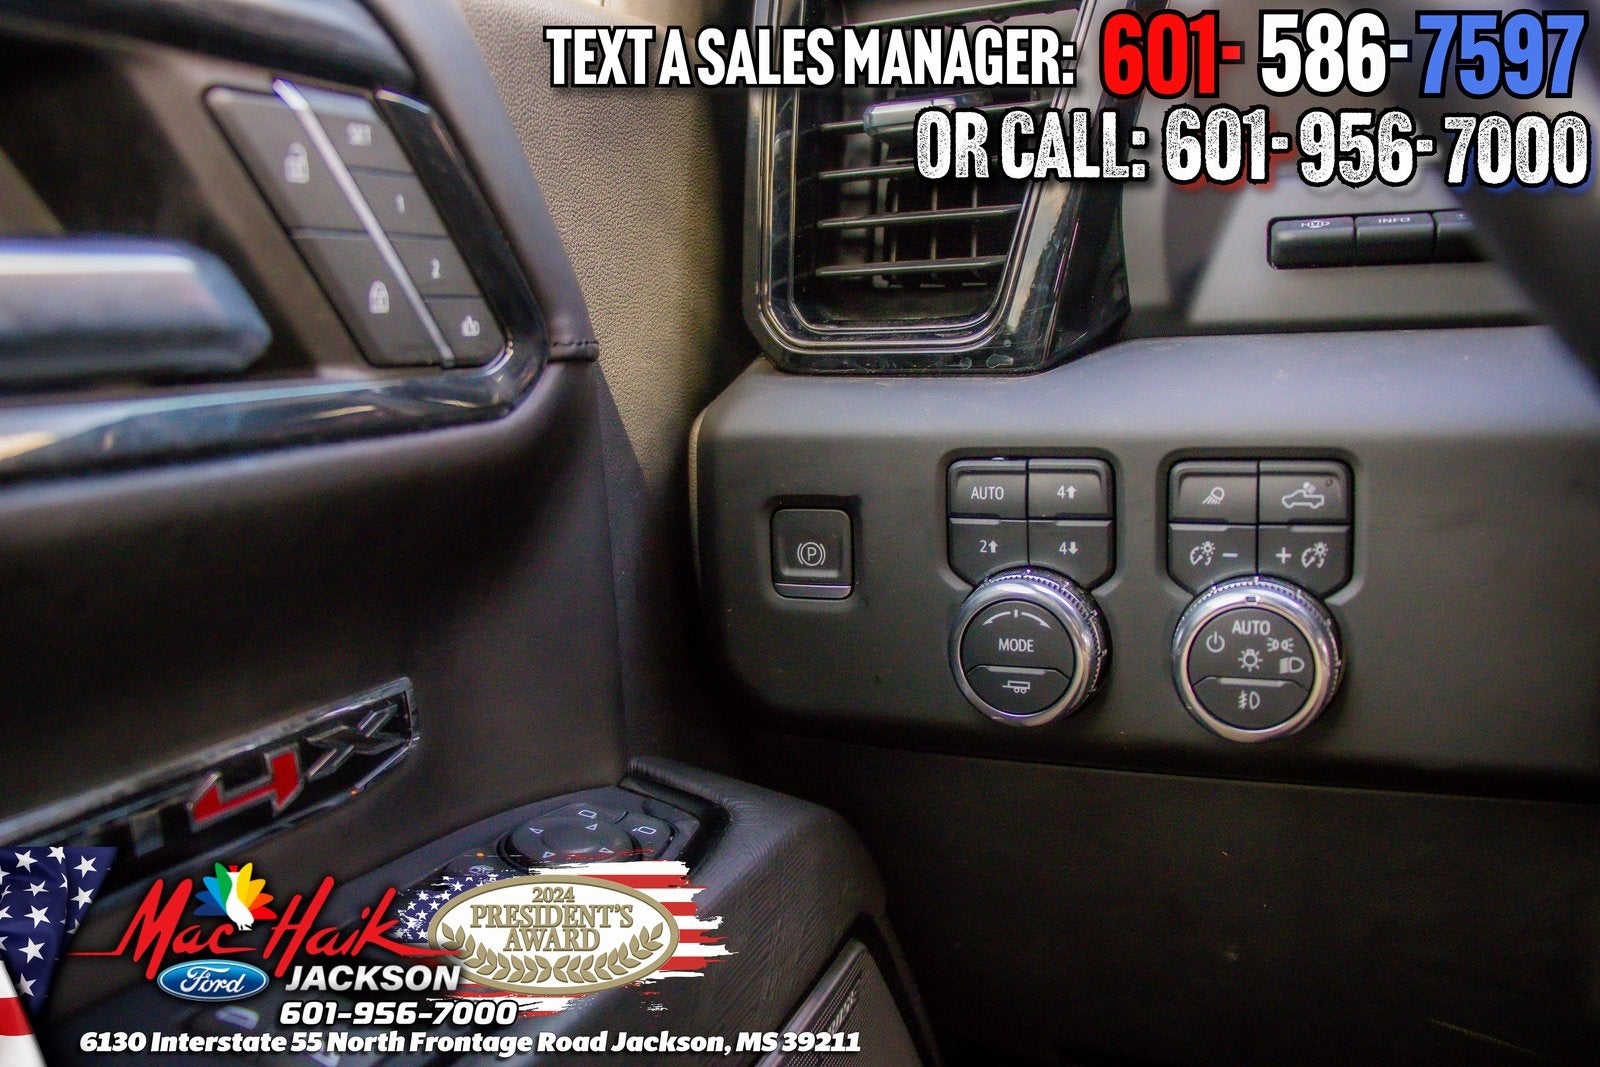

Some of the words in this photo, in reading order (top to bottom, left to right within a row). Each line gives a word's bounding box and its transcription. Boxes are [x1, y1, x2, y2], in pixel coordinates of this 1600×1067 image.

[970, 486, 1005, 501] AUTO
[1231, 620, 1271, 637] AUTO
[998, 638, 1034, 653] MODE
